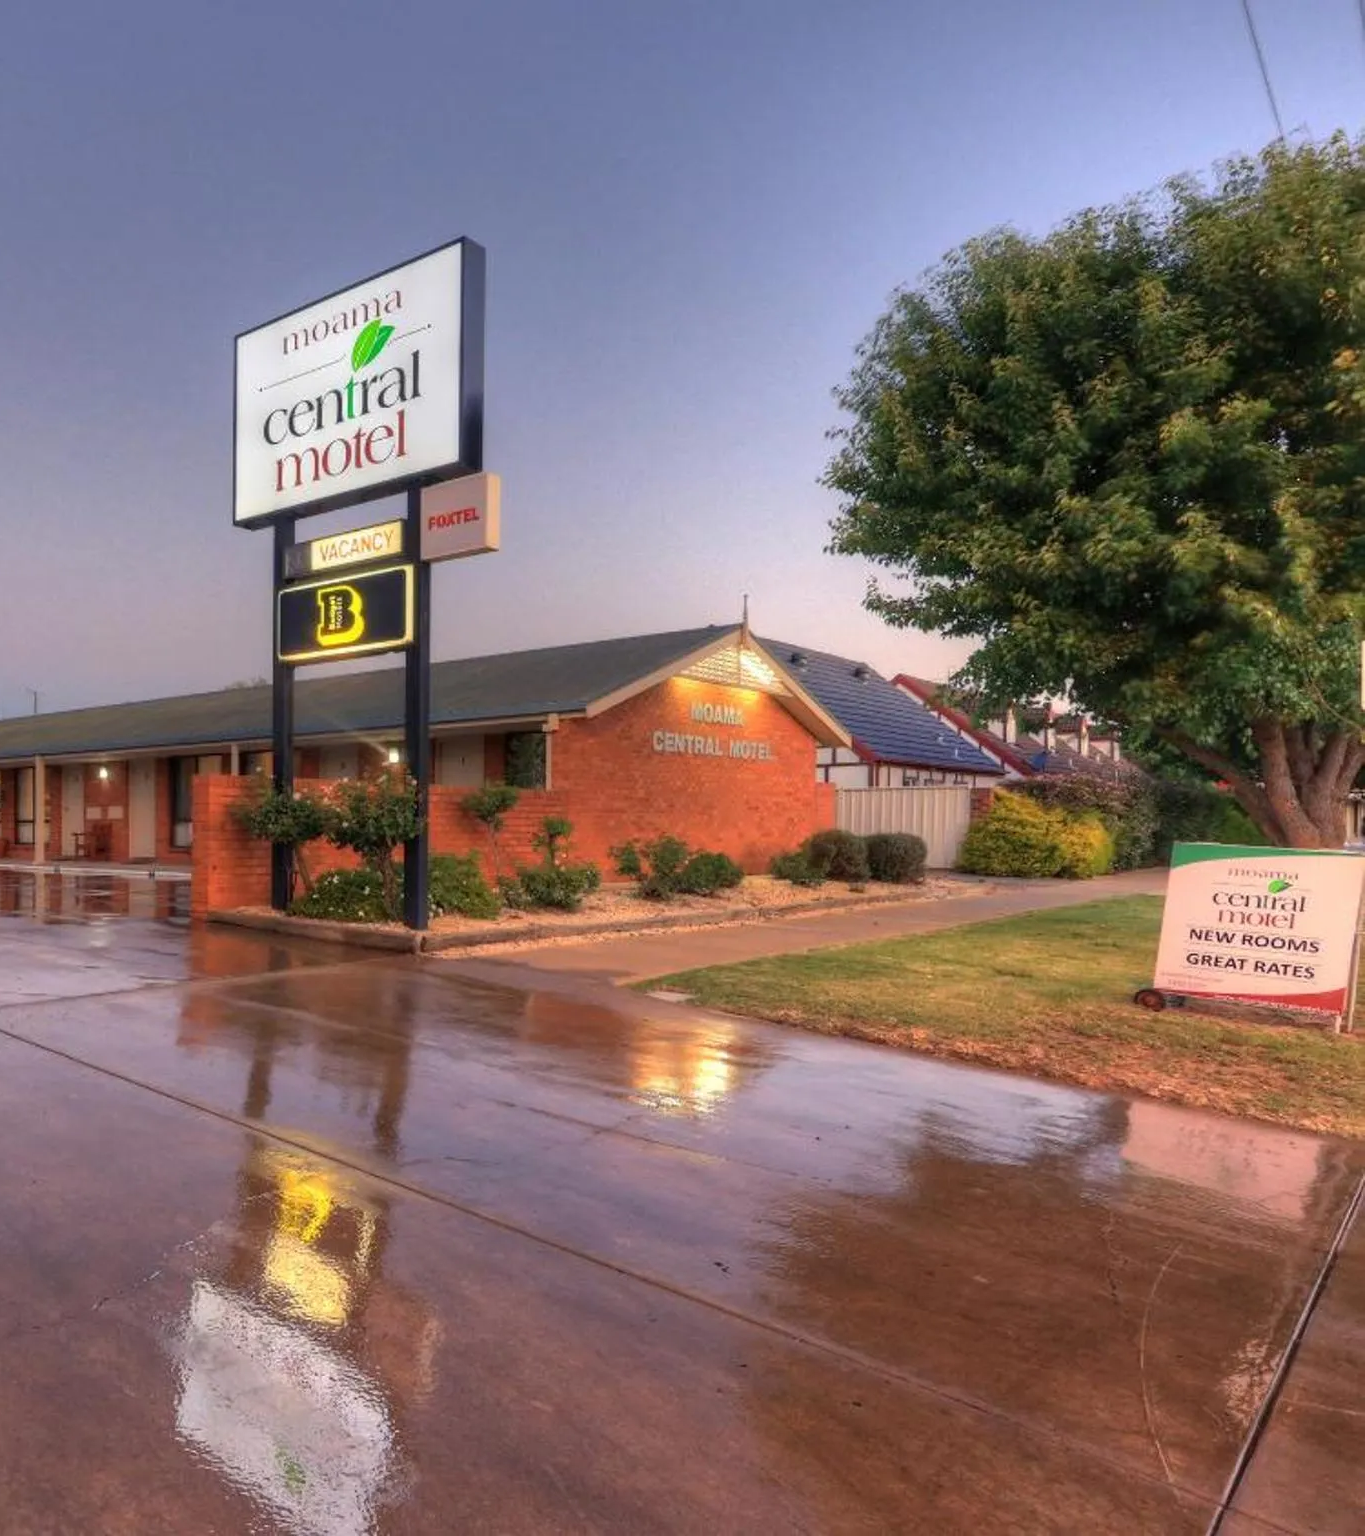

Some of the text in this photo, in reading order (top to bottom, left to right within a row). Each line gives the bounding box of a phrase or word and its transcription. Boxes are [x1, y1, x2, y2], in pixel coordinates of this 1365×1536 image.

[283, 289, 403, 355] moama
[263, 350, 422, 445] central
[275, 409, 407, 492] motel
[428, 507, 480, 530] FOXTEL
[319, 529, 395, 563] VACANCY
[691, 701, 745, 726] MOAMA
[652, 730, 773, 760] CENTRAL MOTEL
[1212, 891, 1306, 912] central
[1218, 909, 1296, 929] motel
[1189, 928, 1320, 953] NEW ROOMS
[1185, 952, 1315, 980] GREAT RATES
